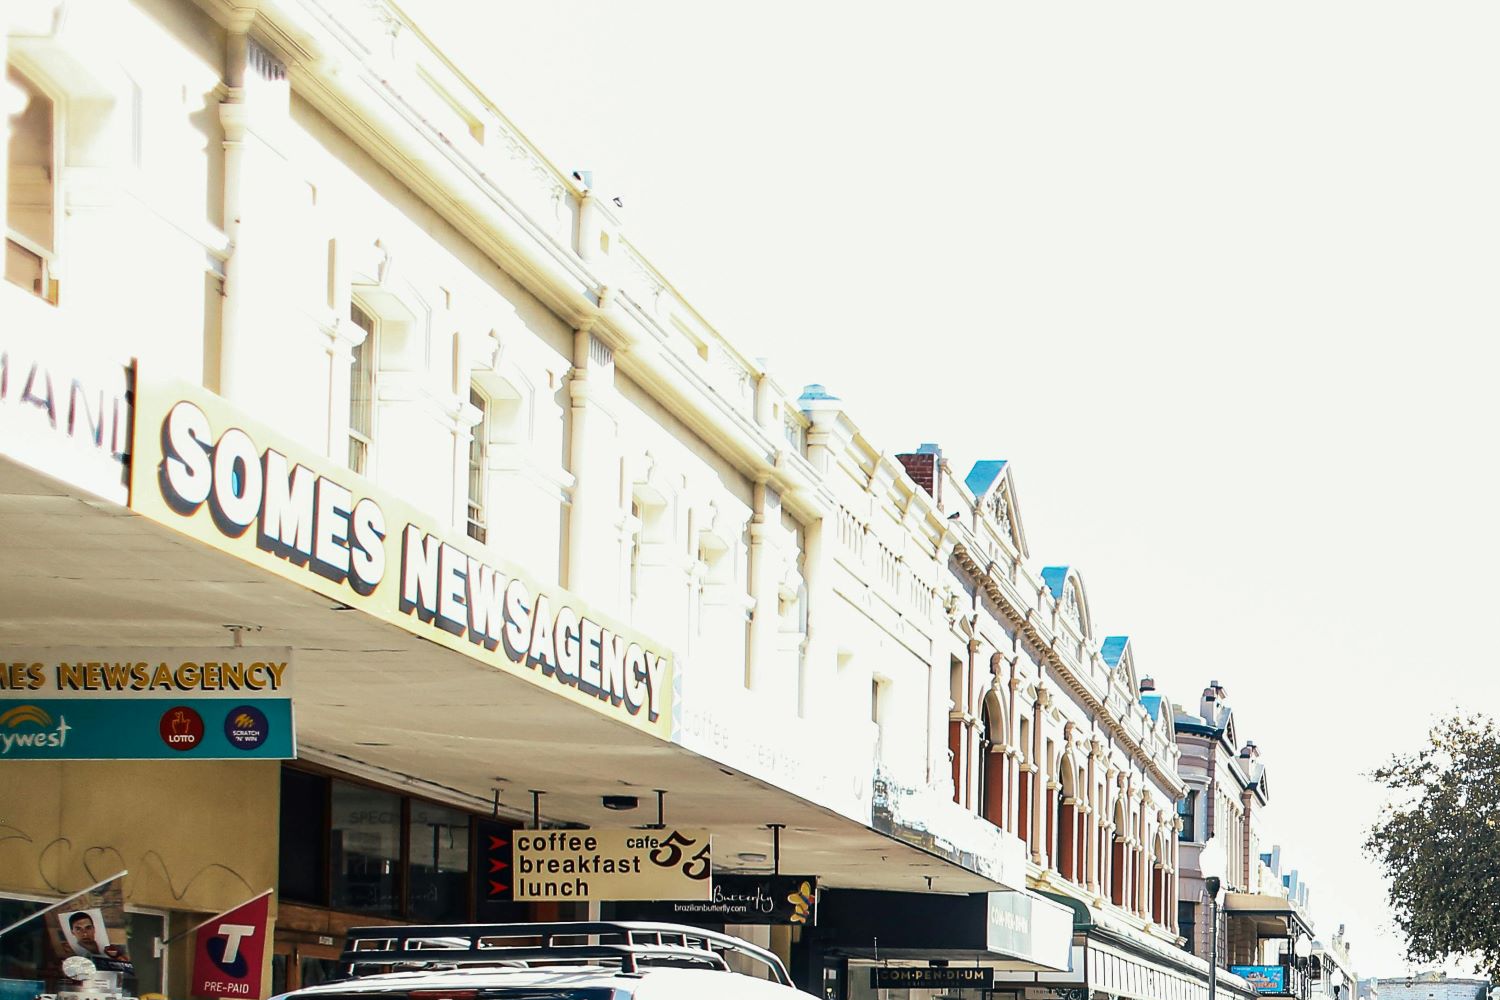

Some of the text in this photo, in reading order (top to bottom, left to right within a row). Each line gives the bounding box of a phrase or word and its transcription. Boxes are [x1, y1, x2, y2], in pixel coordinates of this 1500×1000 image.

[160, 400, 667, 723] SOMES NEWSAGENCY
[57, 662, 289, 690] NEWSAGENCY
[0, 714, 72, 754] ywest
[168, 733, 196, 744] LOTTO
[517, 830, 711, 881] coffee cafe 55
[519, 855, 641, 874] breakfast
[519, 878, 589, 897] lunch
[712, 884, 775, 913] Butterfly
[674, 902, 747, 915] brazilianbutterfly.com
[218, 924, 256, 964] T
[204, 981, 250, 994] PRE-PAID
